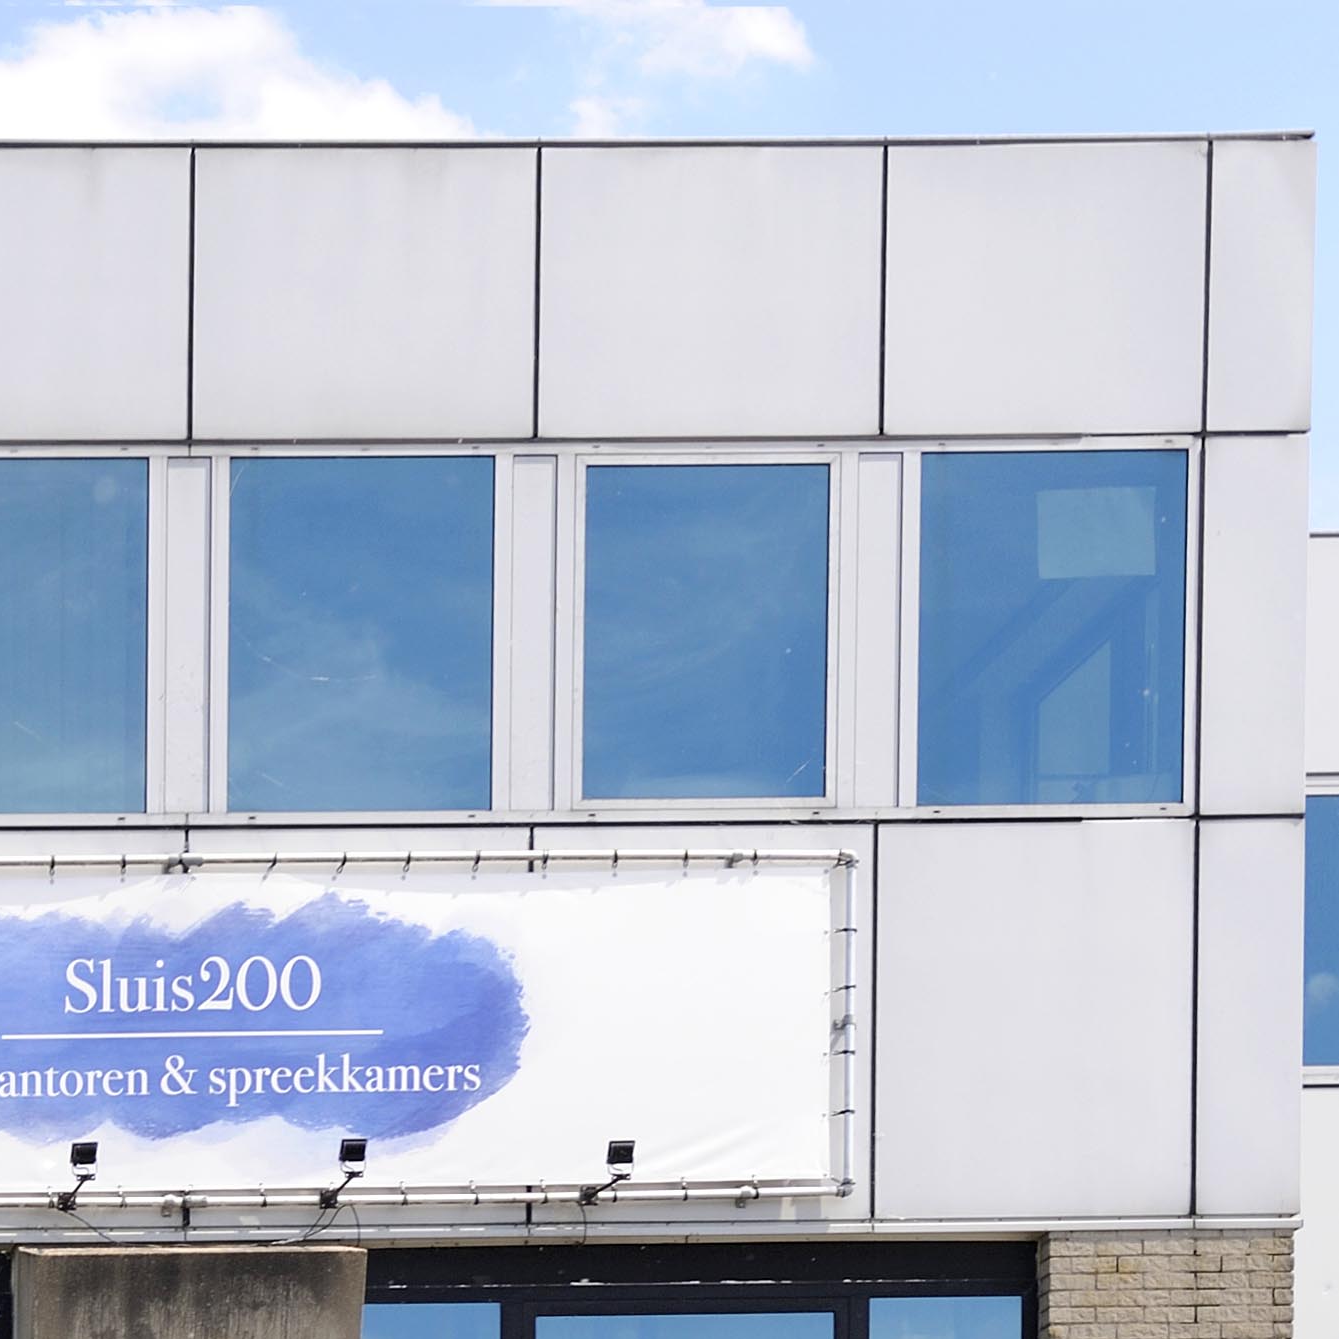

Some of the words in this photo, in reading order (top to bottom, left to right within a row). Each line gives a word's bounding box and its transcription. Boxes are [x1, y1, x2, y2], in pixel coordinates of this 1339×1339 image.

[63, 954, 322, 1014] Sluis200
[160, 1055, 197, 1096] &
[208, 1053, 482, 1107] spreekkamers
